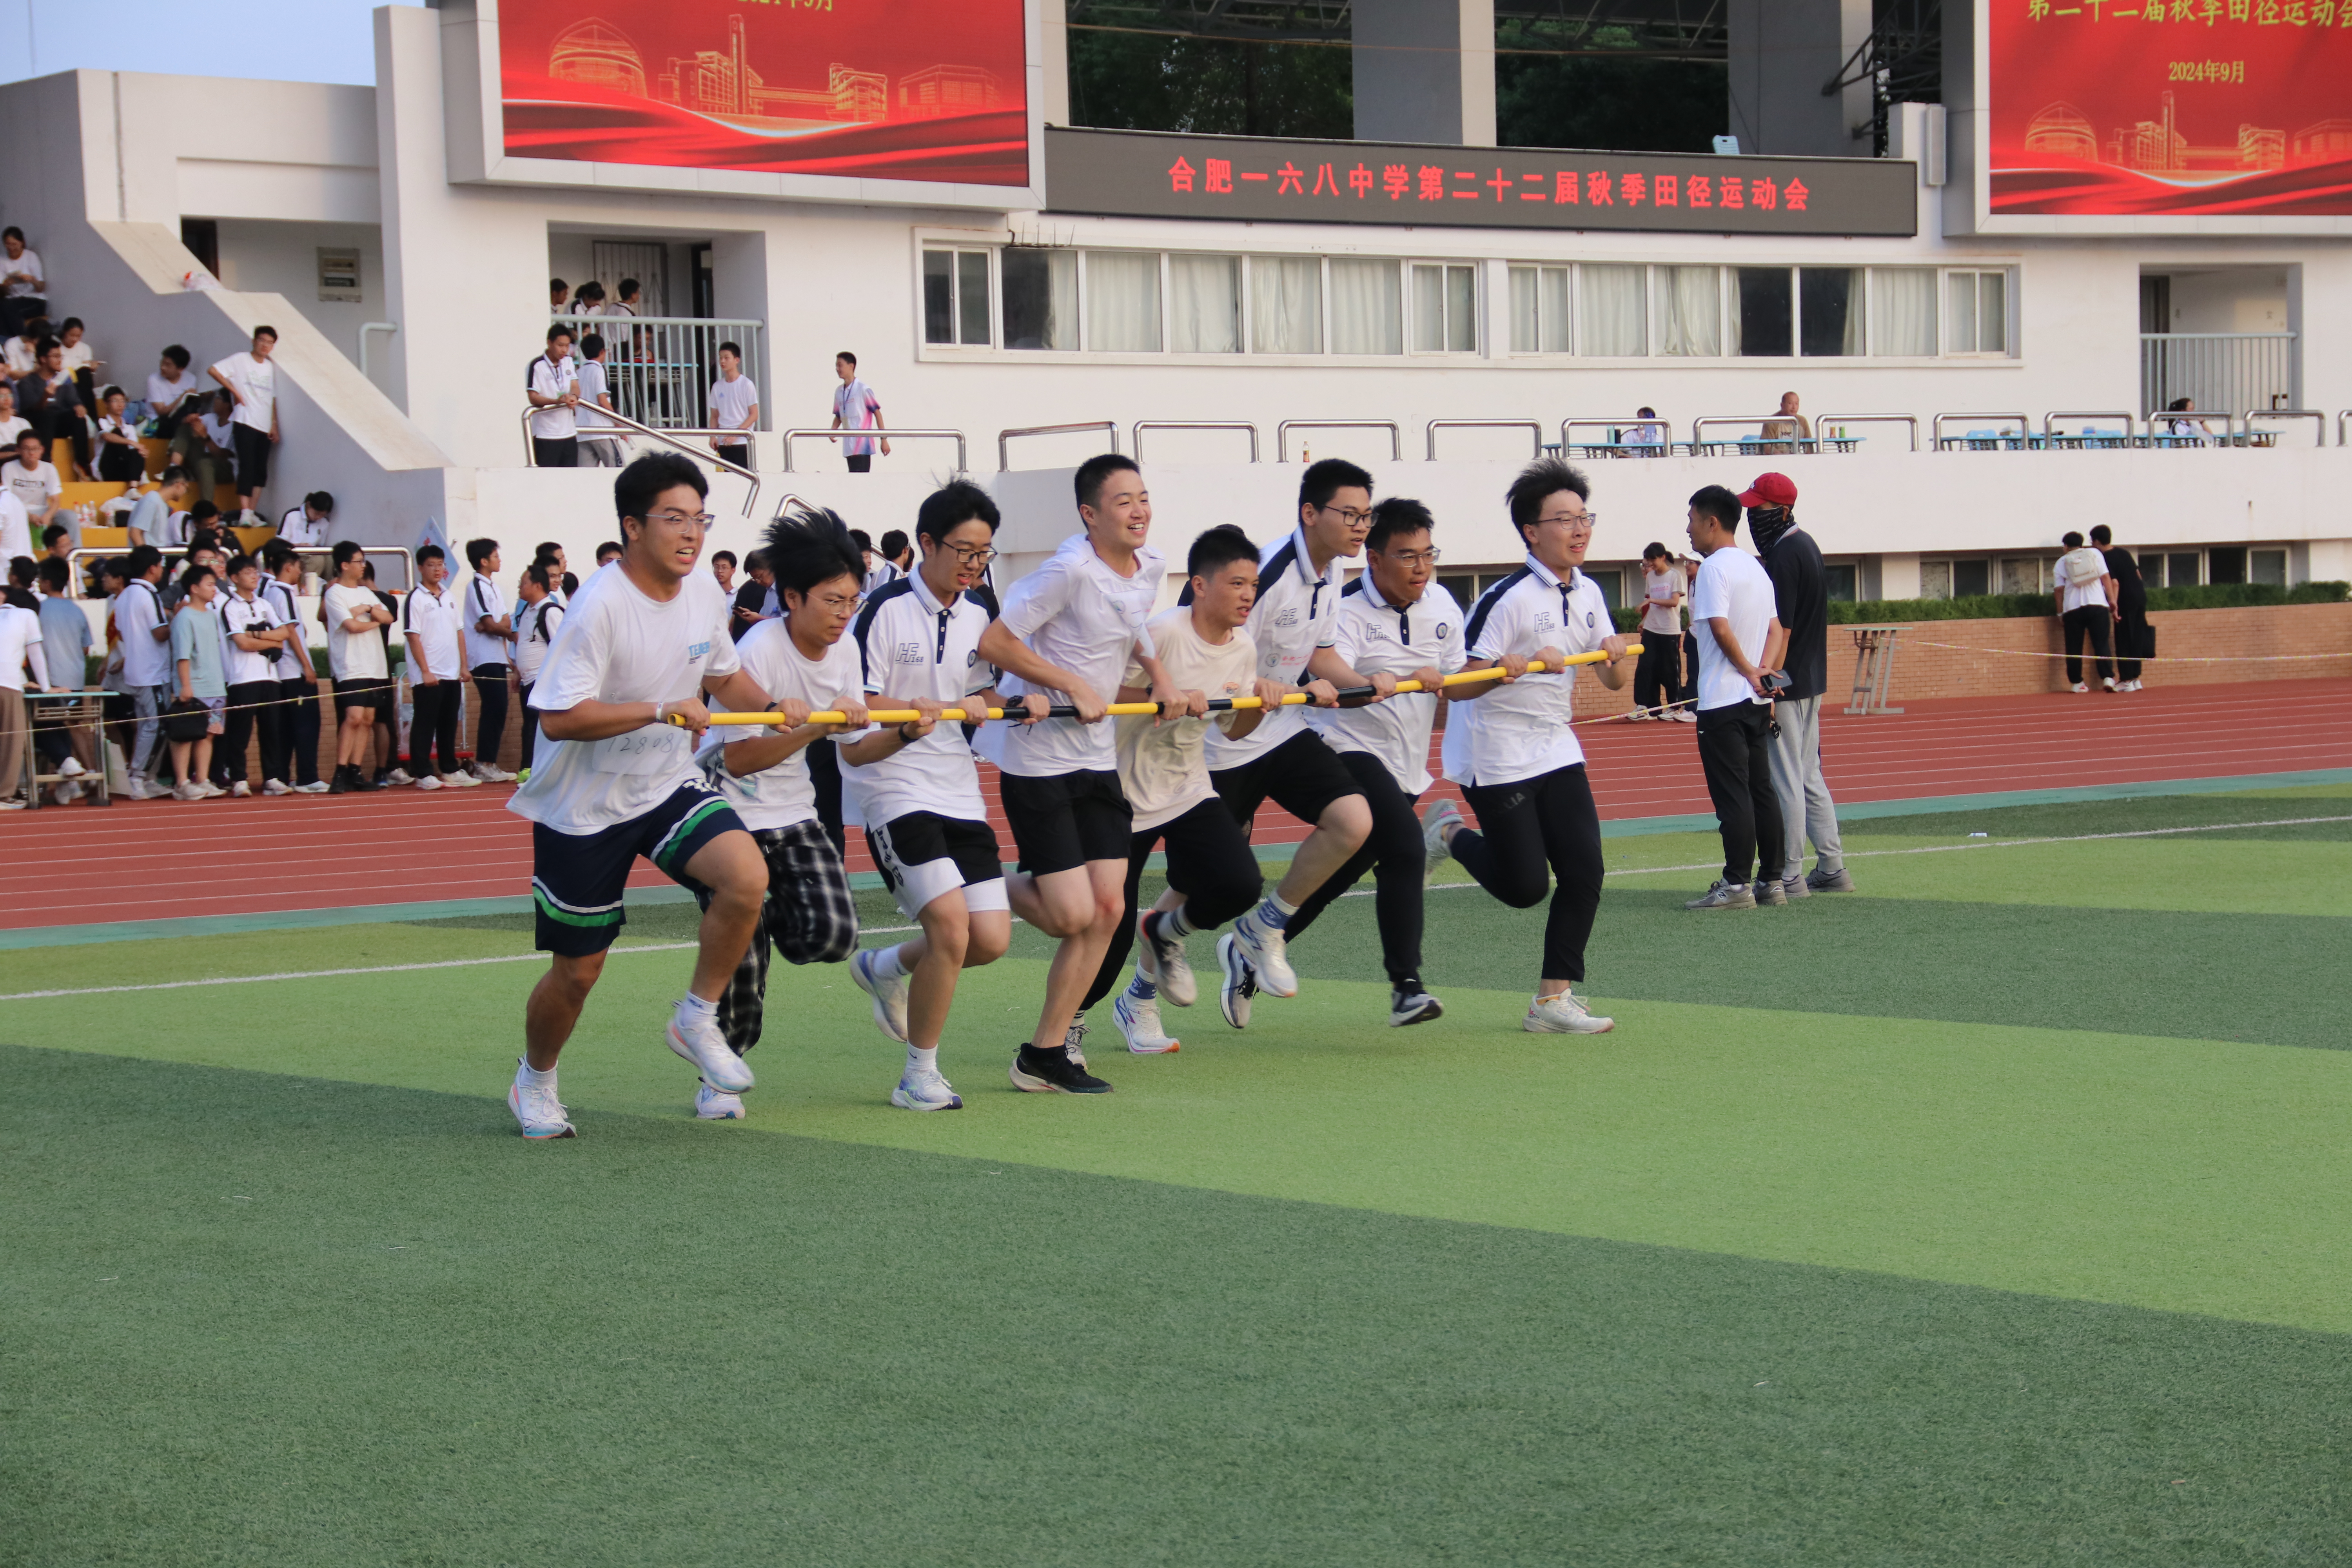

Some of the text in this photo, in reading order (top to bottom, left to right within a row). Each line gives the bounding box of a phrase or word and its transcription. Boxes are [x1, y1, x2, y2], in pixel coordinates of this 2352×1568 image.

[2169, 59, 2244, 83] 2024年9月
[1168, 156, 1809, 211] 合肥一六八中学第二十二届秋季田径运动会
[608, 733, 674, 754] 12808
